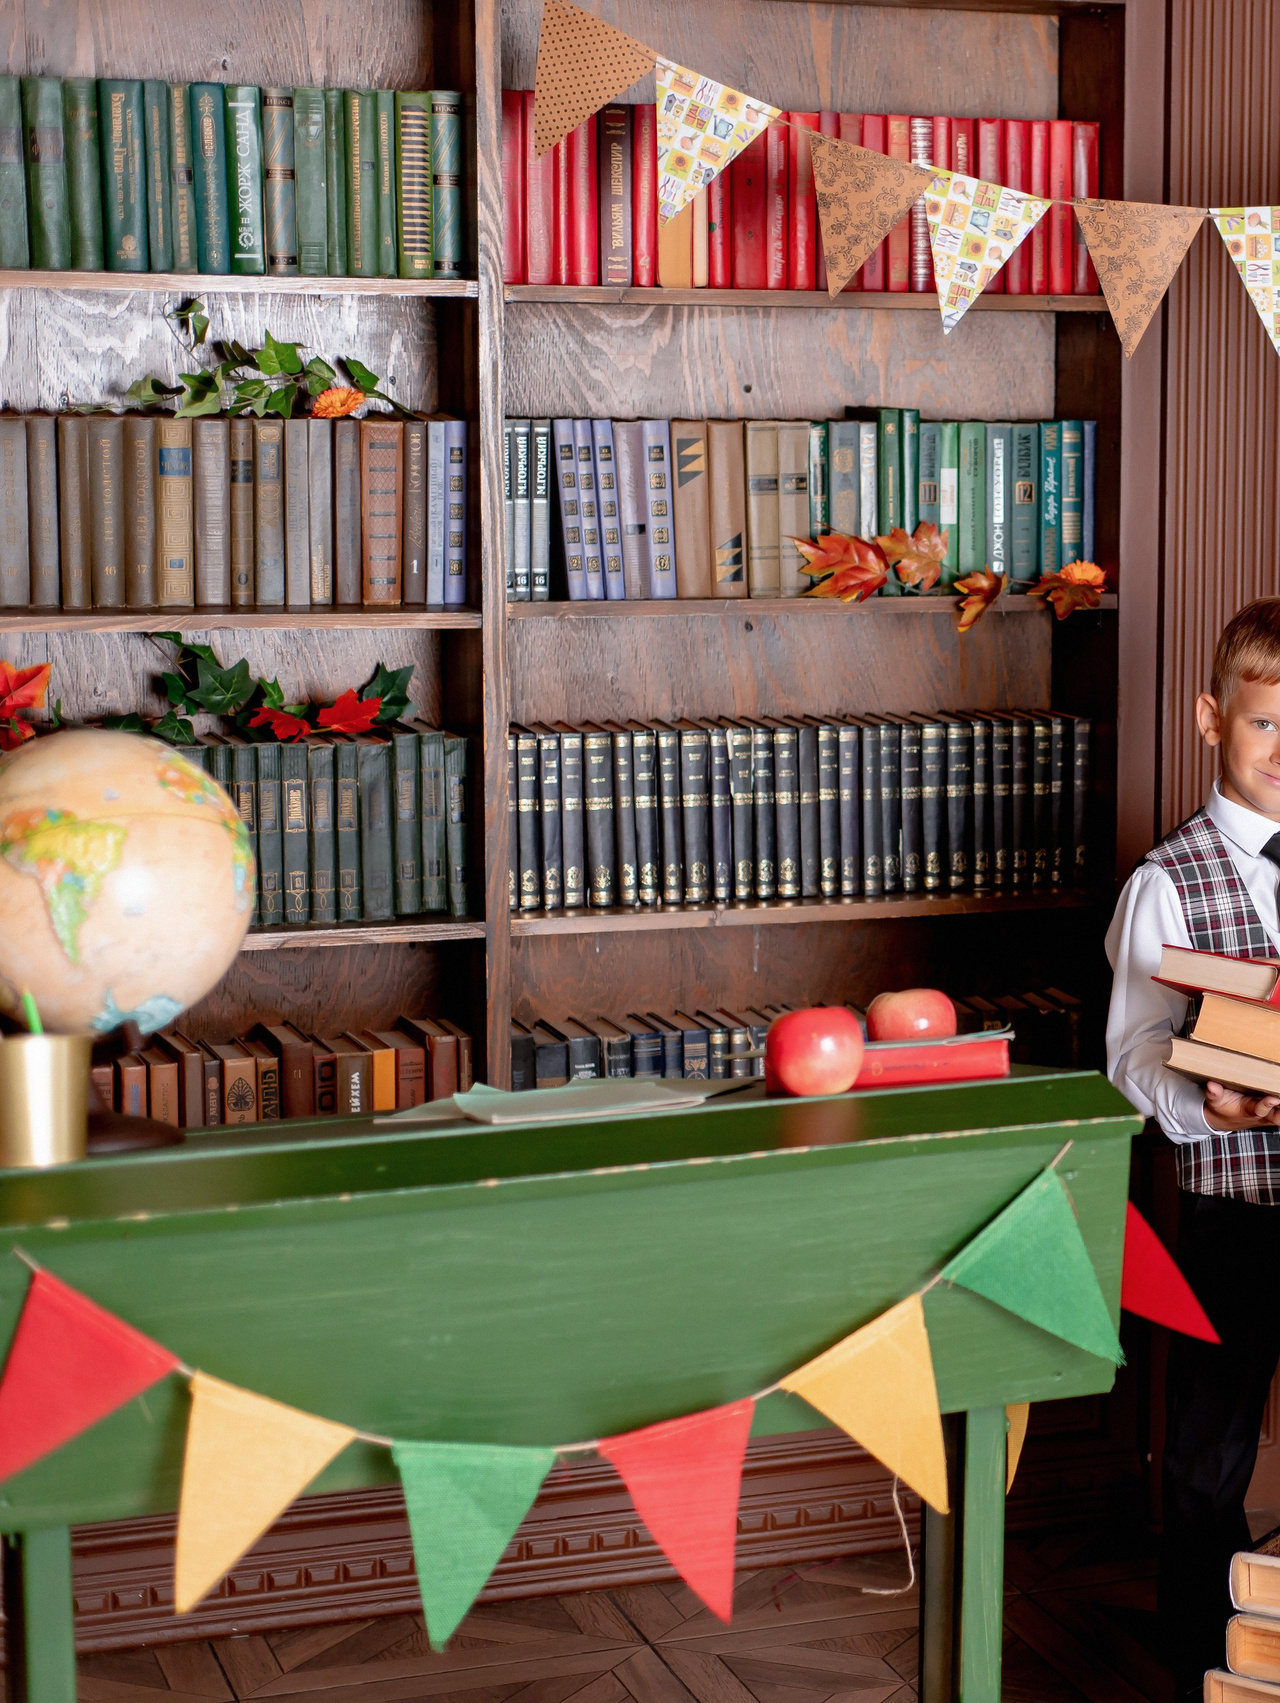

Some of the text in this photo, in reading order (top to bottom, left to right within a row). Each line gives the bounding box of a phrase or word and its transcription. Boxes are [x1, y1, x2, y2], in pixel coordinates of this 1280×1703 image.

[235, 110, 251, 156] САНД
[380, 112, 388, 158] ШОЛОХОВ
[237, 162, 253, 213] ЖОРЖ
[610, 142, 624, 249] ВИЛЬЯМ ШЕКСПИР
[99, 439, 112, 506] ТОЛСТОЙ
[135, 439, 146, 505] ТОЛСТОЙ
[516, 436, 527, 495] М.ГОРЬКИЙ
[536, 436, 547, 495] М.ГОРЬКИЙ
[1018, 434, 1031, 478] БАЛЬЗАК
[1018, 484, 1032, 502] 12
[993, 524, 1004, 560] ДЖОН
[137, 564, 147, 574] 17
[411, 560, 418, 574] 1
[517, 576, 527, 585] 16
[535, 576, 545, 585] 16
[288, 789, 303, 822] Диккенс
[349, 1071, 361, 1113] ЕЙХЕМ
